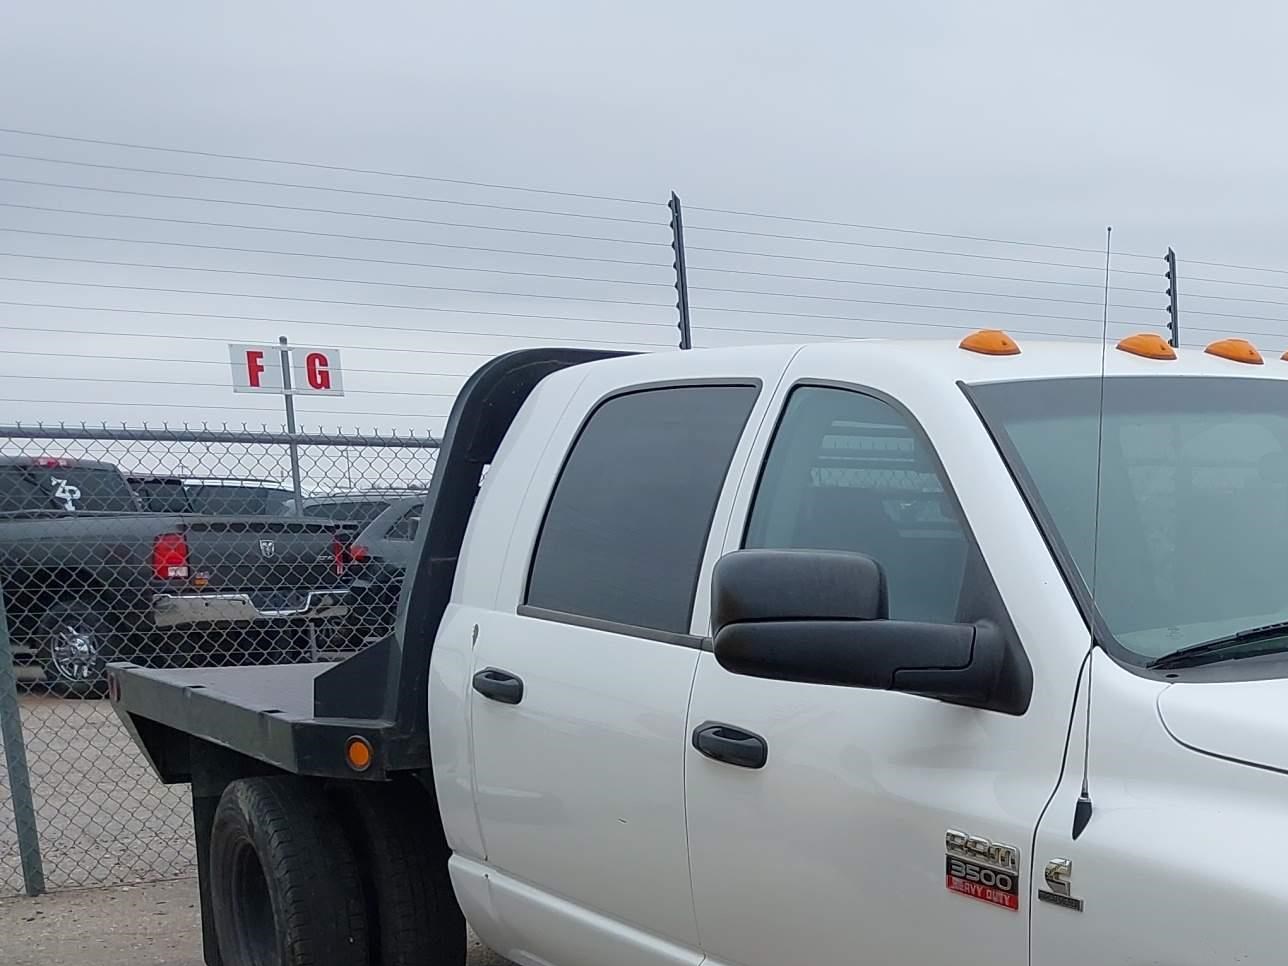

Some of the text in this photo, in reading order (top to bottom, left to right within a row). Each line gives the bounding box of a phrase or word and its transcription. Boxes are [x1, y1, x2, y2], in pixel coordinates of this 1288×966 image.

[245, 350, 265, 388] F
[306, 352, 331, 390] G
[950, 857, 1013, 891] 3500
[950, 877, 1011, 906] HEAVY DUTY
